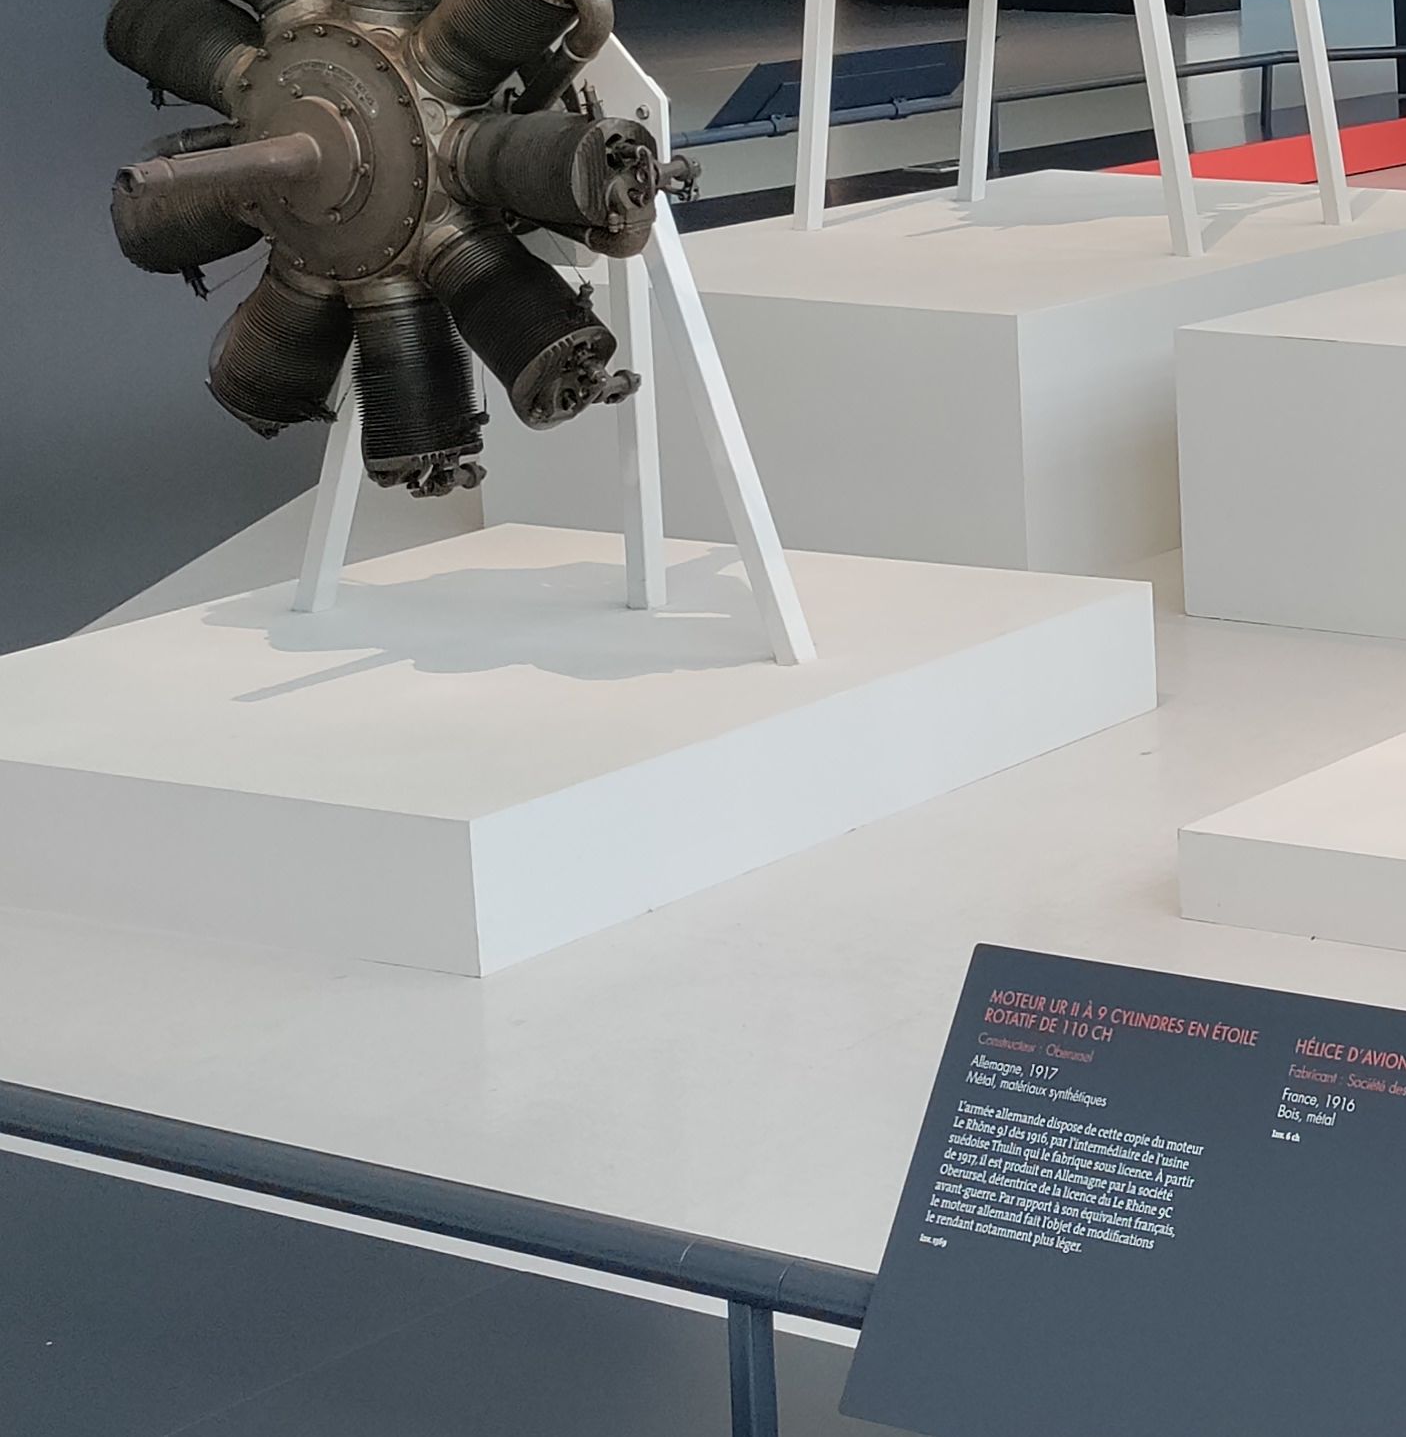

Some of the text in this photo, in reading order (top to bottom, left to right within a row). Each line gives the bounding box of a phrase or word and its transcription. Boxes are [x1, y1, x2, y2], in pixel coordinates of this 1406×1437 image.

[984, 1007, 1113, 1042] ROTATIF DE 110 CH
[989, 990, 1258, 1046] MOTEUR UR II À 9 CYLINDRES EN ÉTOILE
[1295, 1036, 1344, 1060] HÉLICE
[970, 1054, 1058, 1080] Allemagne, 1917
[1288, 1064, 1337, 1083] Fabricant
[1347, 1073, 1385, 1091] Société
[1388, 1080, 1406, 1096] des
[1281, 1087, 1355, 1112] France, 1916
[957, 1100, 1204, 1155] L'armée allemande dispose de cette copie du moteur
[1277, 1104, 1336, 1126] Bois, métal
